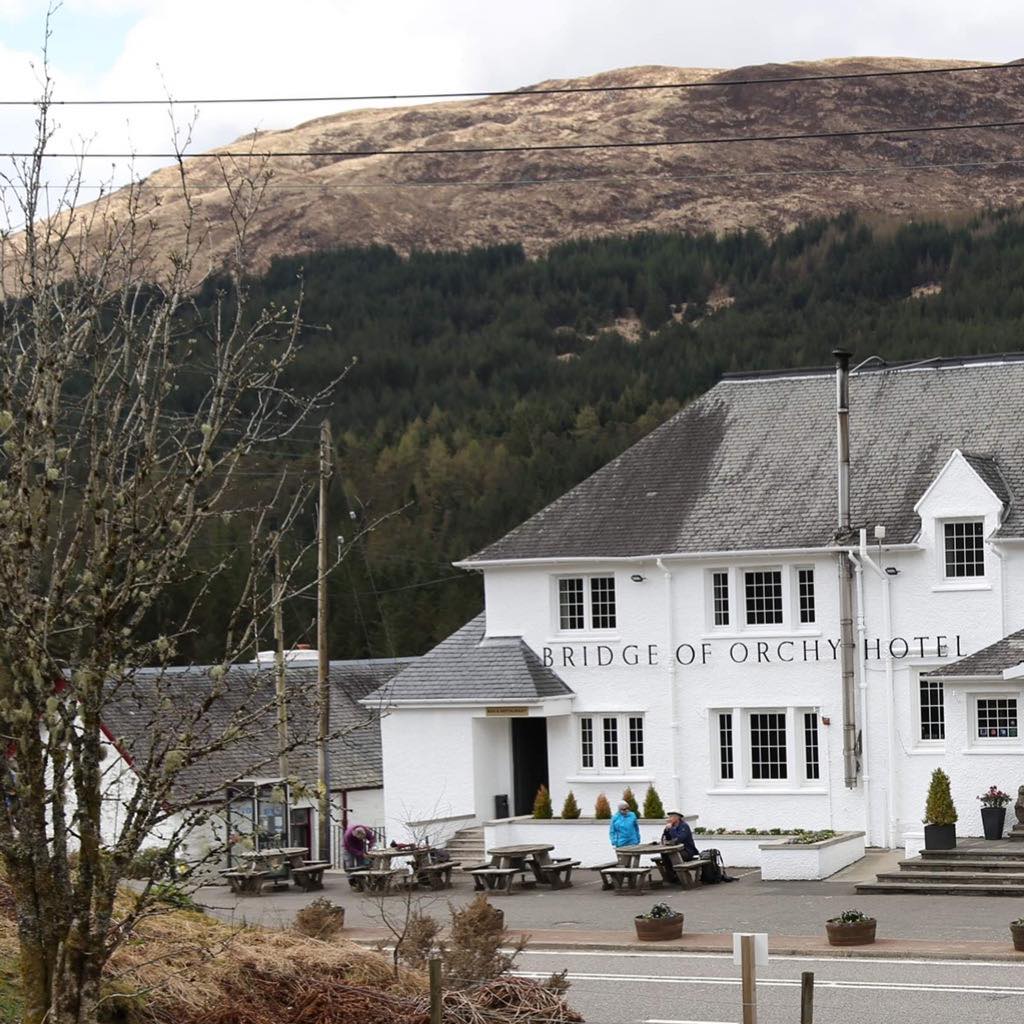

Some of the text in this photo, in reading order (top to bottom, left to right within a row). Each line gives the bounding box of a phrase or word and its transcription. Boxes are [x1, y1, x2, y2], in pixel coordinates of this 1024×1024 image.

[543, 635, 967, 668] BRIDGE OF ORCHY HOTEL
